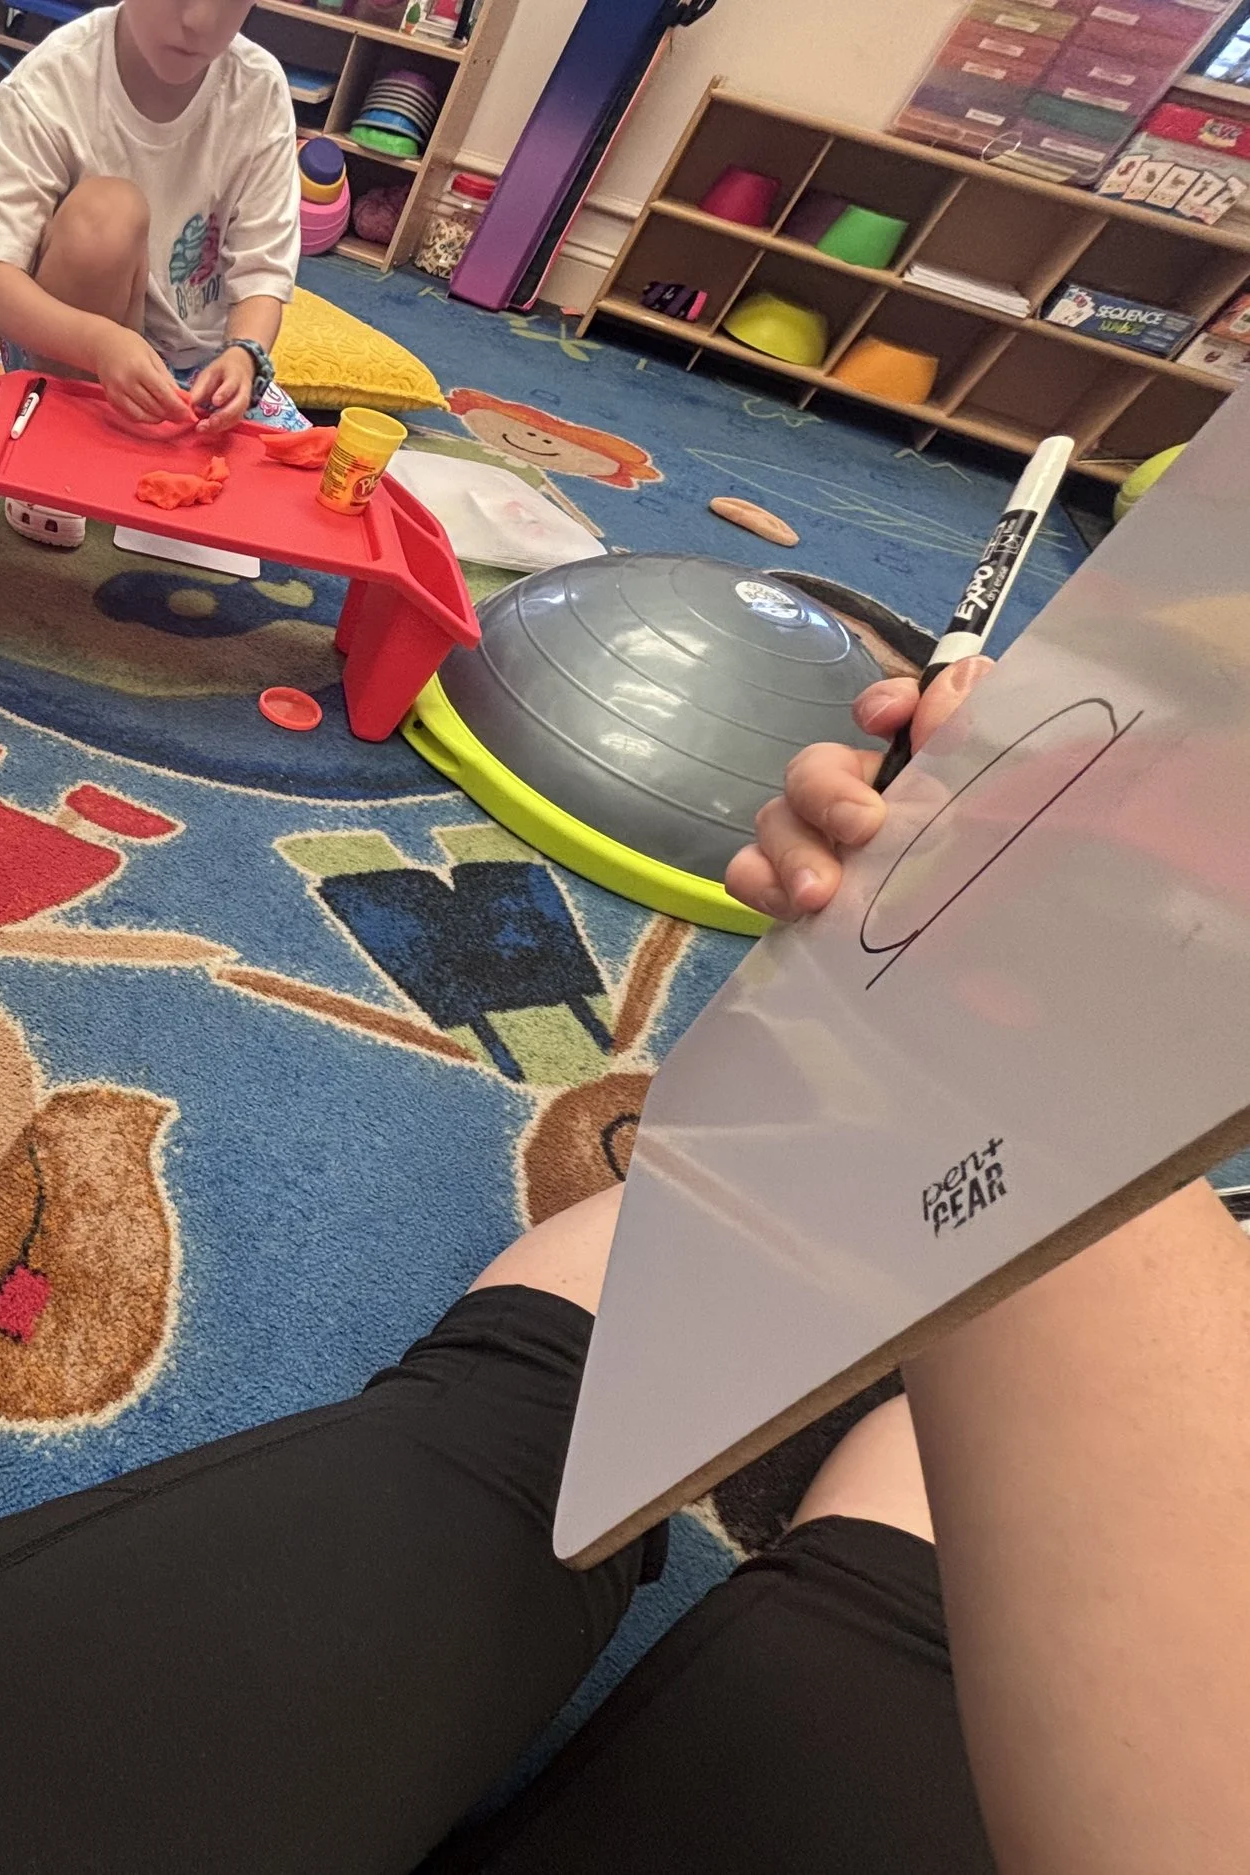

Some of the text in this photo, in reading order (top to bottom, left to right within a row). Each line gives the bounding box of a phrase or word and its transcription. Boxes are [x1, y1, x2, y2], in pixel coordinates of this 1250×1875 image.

[1095, 304, 1167, 326] SEQUENCE
[953, 565, 994, 621] EXPO
[983, 587, 1001, 602] dry
[932, 1162, 1007, 1239] GEAR
